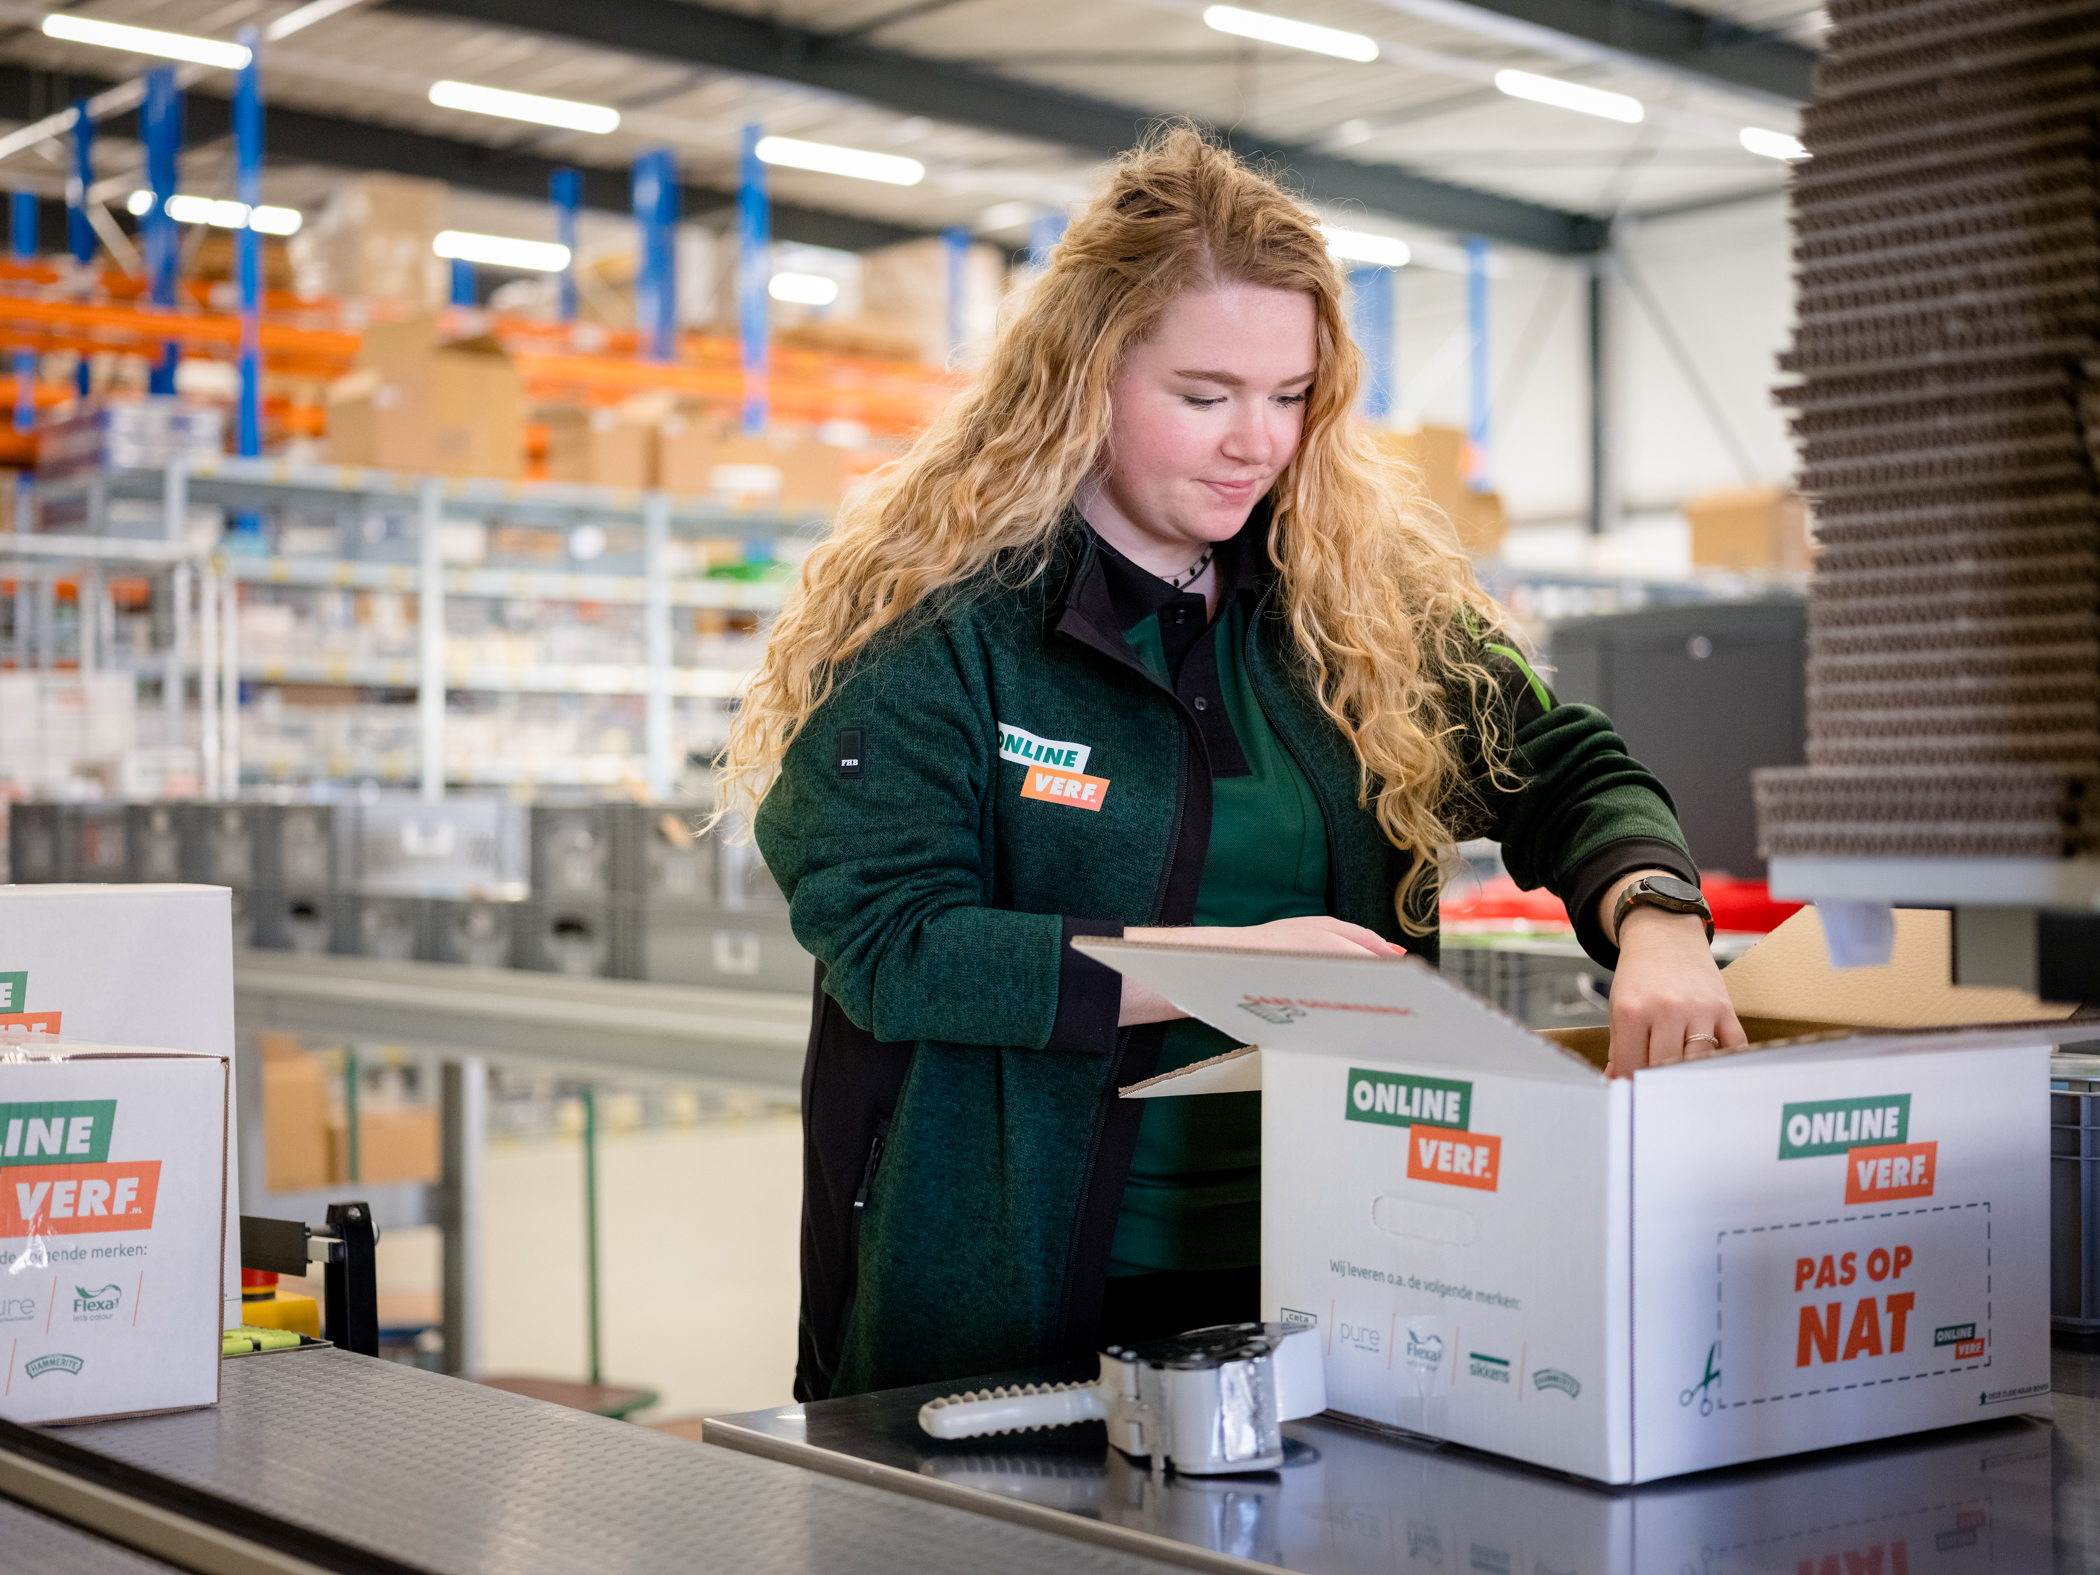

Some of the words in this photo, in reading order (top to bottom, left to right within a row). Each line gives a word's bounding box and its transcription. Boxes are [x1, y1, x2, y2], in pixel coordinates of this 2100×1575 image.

[840, 759, 858, 767] FHB
[1353, 1080, 1461, 1123] ONLINE
[0, 1116, 94, 1157] INE
[1786, 1106, 1900, 1147] ONLINE
[91, 1243, 147, 1259] merken:
[1794, 1251, 1857, 1292] PAS
[1866, 1245, 1913, 1282] OP
[1329, 1259, 1346, 1277] Wij
[1347, 1261, 1386, 1283] leveren
[1387, 1272, 1406, 1287] o.a.
[1407, 1275, 1421, 1291] de
[1423, 1279, 1473, 1300] volgende
[73, 1298, 115, 1313] Flexa
[90, 1313, 113, 1321] colour
[1289, 1313, 1309, 1323] ceta
[1341, 1323, 1380, 1346] pure
[1796, 1291, 1915, 1368] NAT
[1936, 1326, 1973, 1343] ONLINE
[30, 1358, 79, 1374] HAMMERITE
